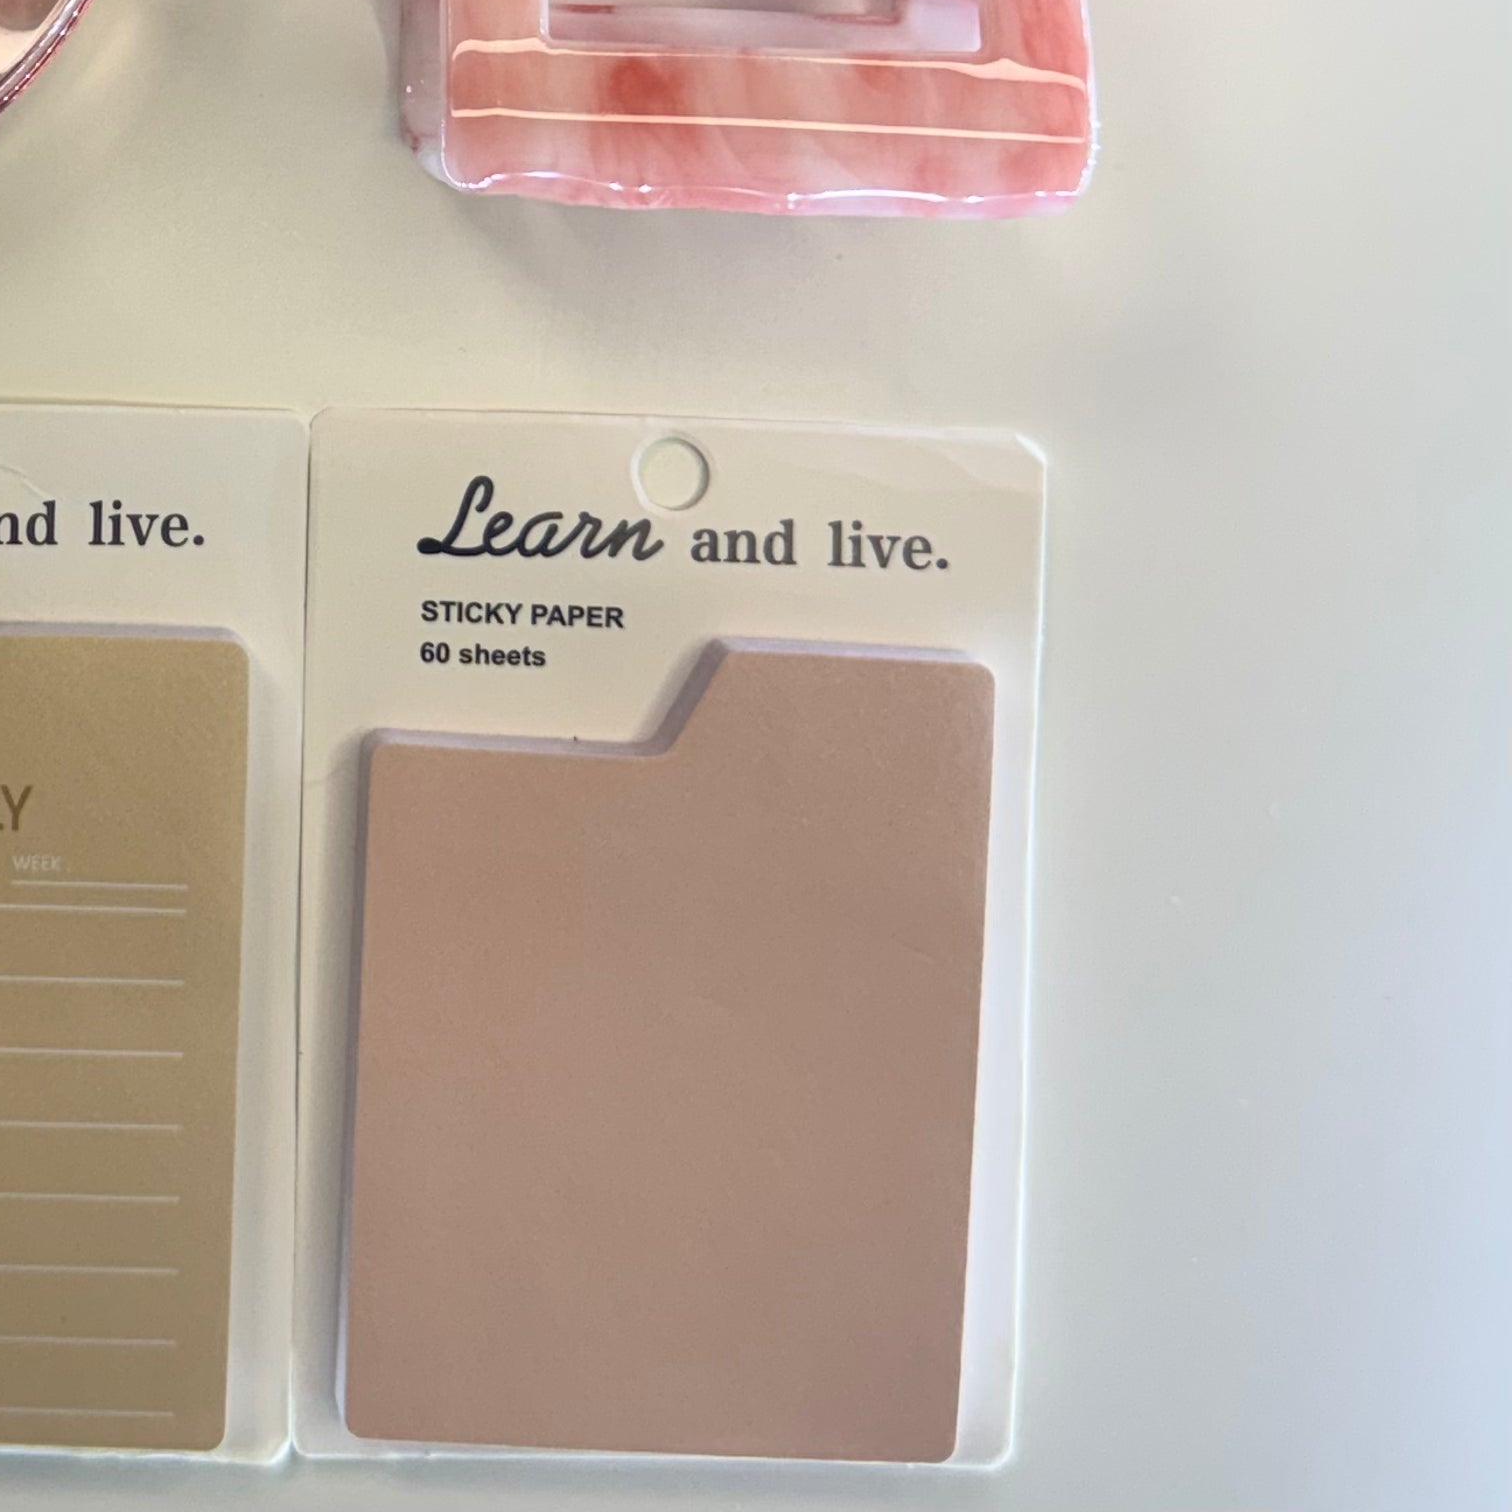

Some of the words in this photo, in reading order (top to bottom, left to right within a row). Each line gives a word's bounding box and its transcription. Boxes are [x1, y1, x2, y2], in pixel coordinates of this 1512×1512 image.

[87, 500, 206, 547] live.
[416, 475, 665, 561] Learn
[690, 518, 798, 566] and
[826, 519, 950, 570] live.
[420, 600, 524, 626] STICKY
[530, 603, 625, 629] PAPER
[419, 642, 451, 665] 60
[458, 643, 547, 668] sheets
